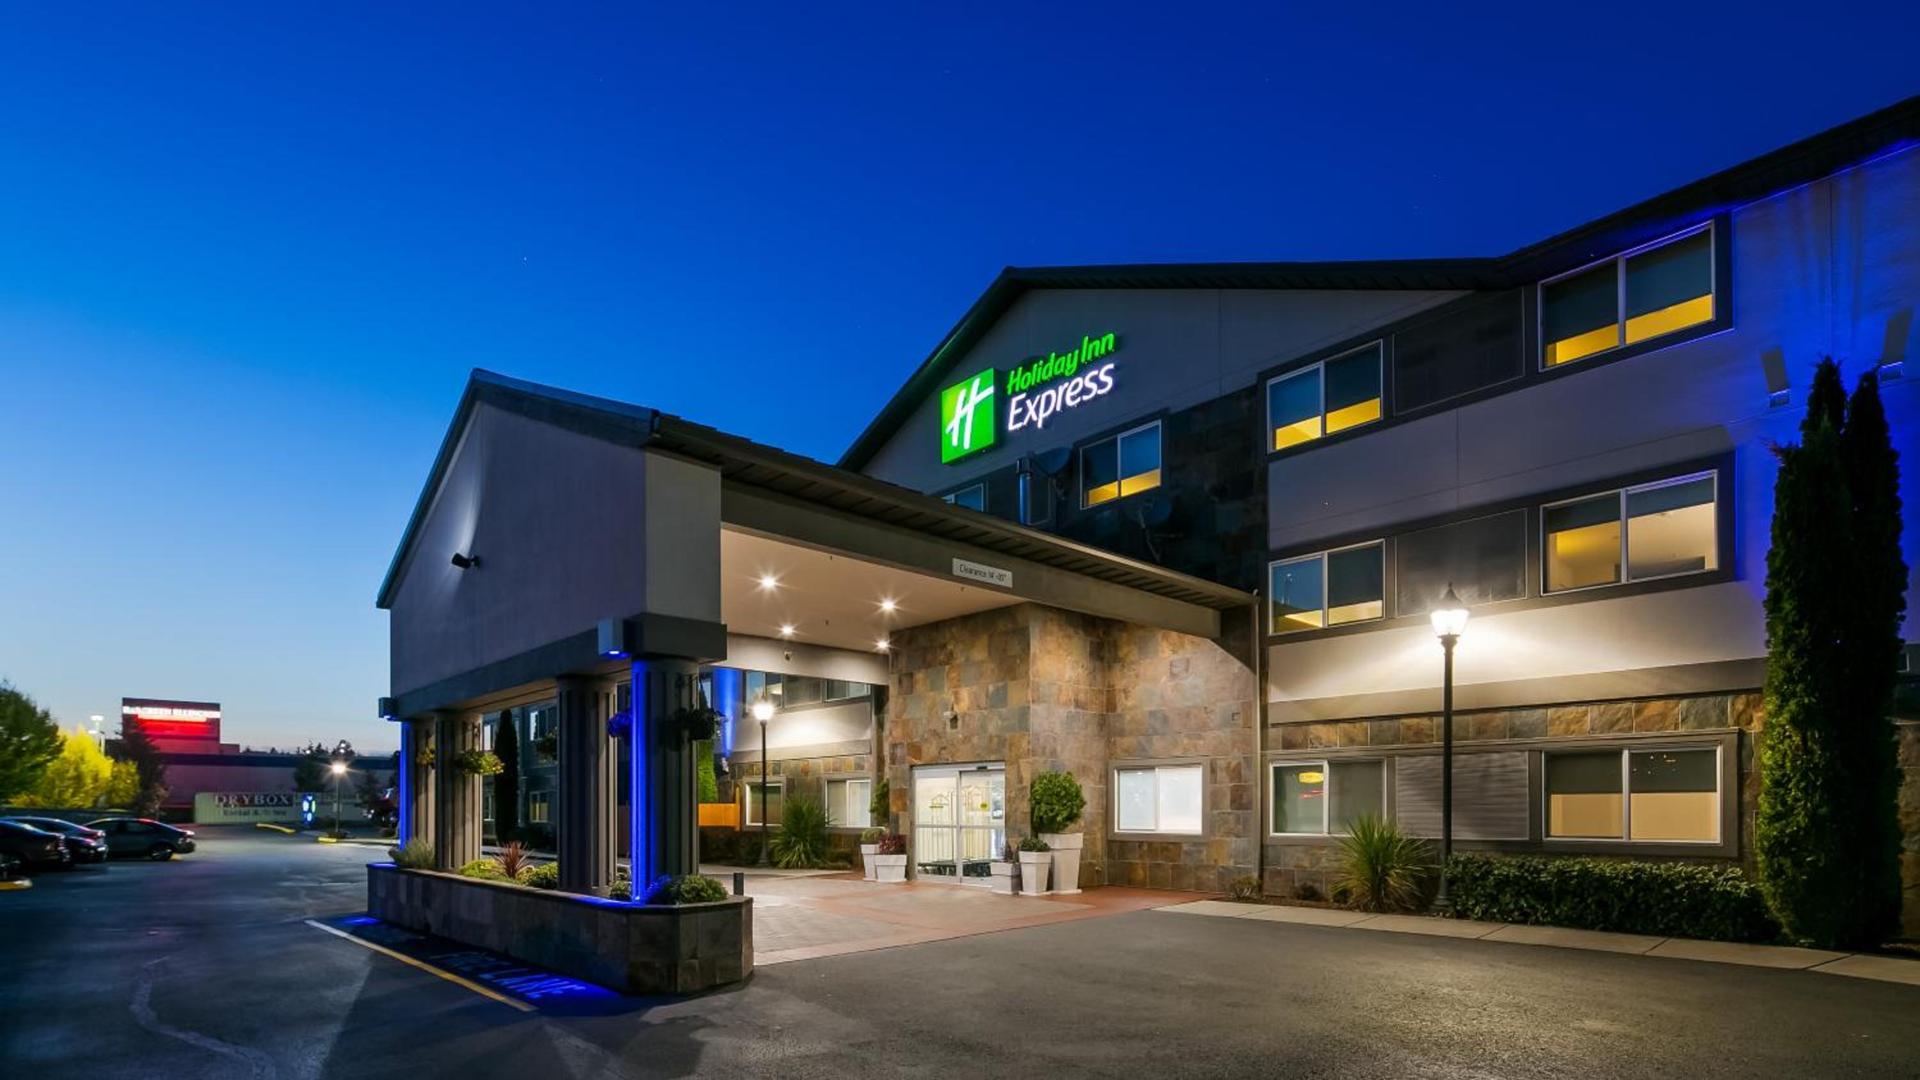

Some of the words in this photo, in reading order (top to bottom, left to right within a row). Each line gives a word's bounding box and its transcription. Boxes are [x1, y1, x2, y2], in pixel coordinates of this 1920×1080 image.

[1009, 350, 1077, 394] Holiday
[1081, 333, 1115, 363] Inn
[1008, 364, 1114, 431] Express
